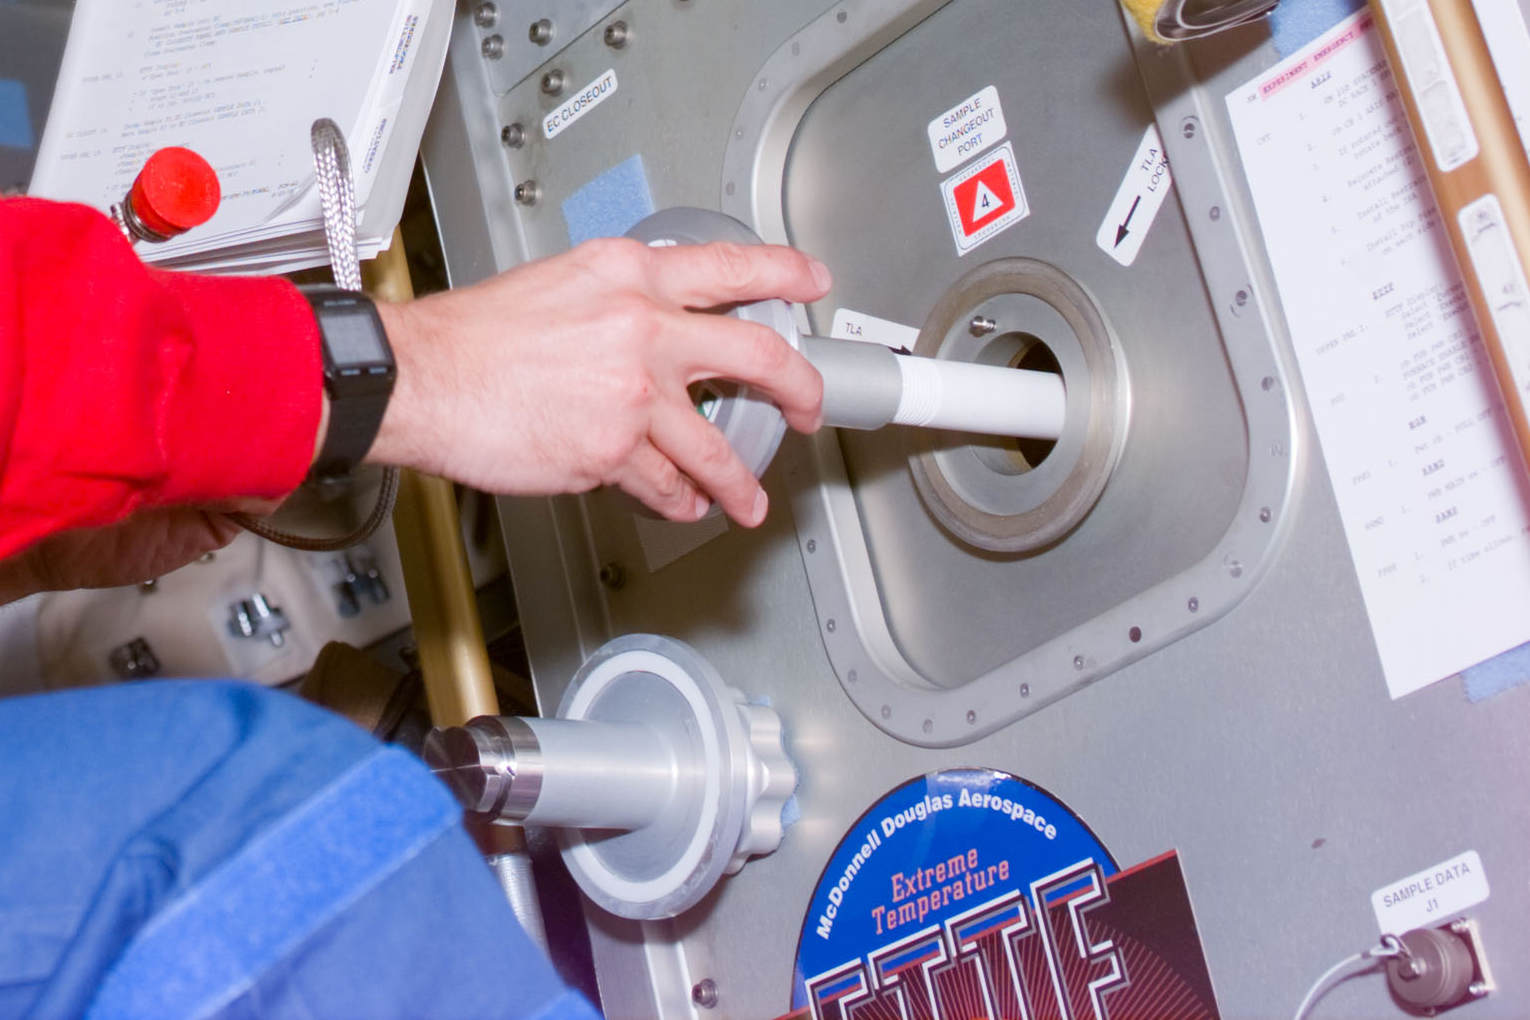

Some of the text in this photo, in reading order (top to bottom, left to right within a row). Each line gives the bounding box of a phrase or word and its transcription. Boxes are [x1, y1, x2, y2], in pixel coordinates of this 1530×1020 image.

[546, 76, 612, 132] EC CLOSEOUT
[943, 97, 981, 128] SAMPLE
[938, 107, 995, 149] CHANGEOUT
[957, 133, 983, 157] PORT
[1140, 148, 1158, 172] TLA
[981, 193, 991, 209] 4
[845, 322, 863, 337] TLA
[816, 787, 1058, 940] McDonnell Douglas Aerospace
[890, 847, 979, 903] Extreme
[871, 860, 1010, 935] Temperature
[1383, 862, 1471, 908] SAMPLE DATA
[1426, 898, 1439, 912] J1
